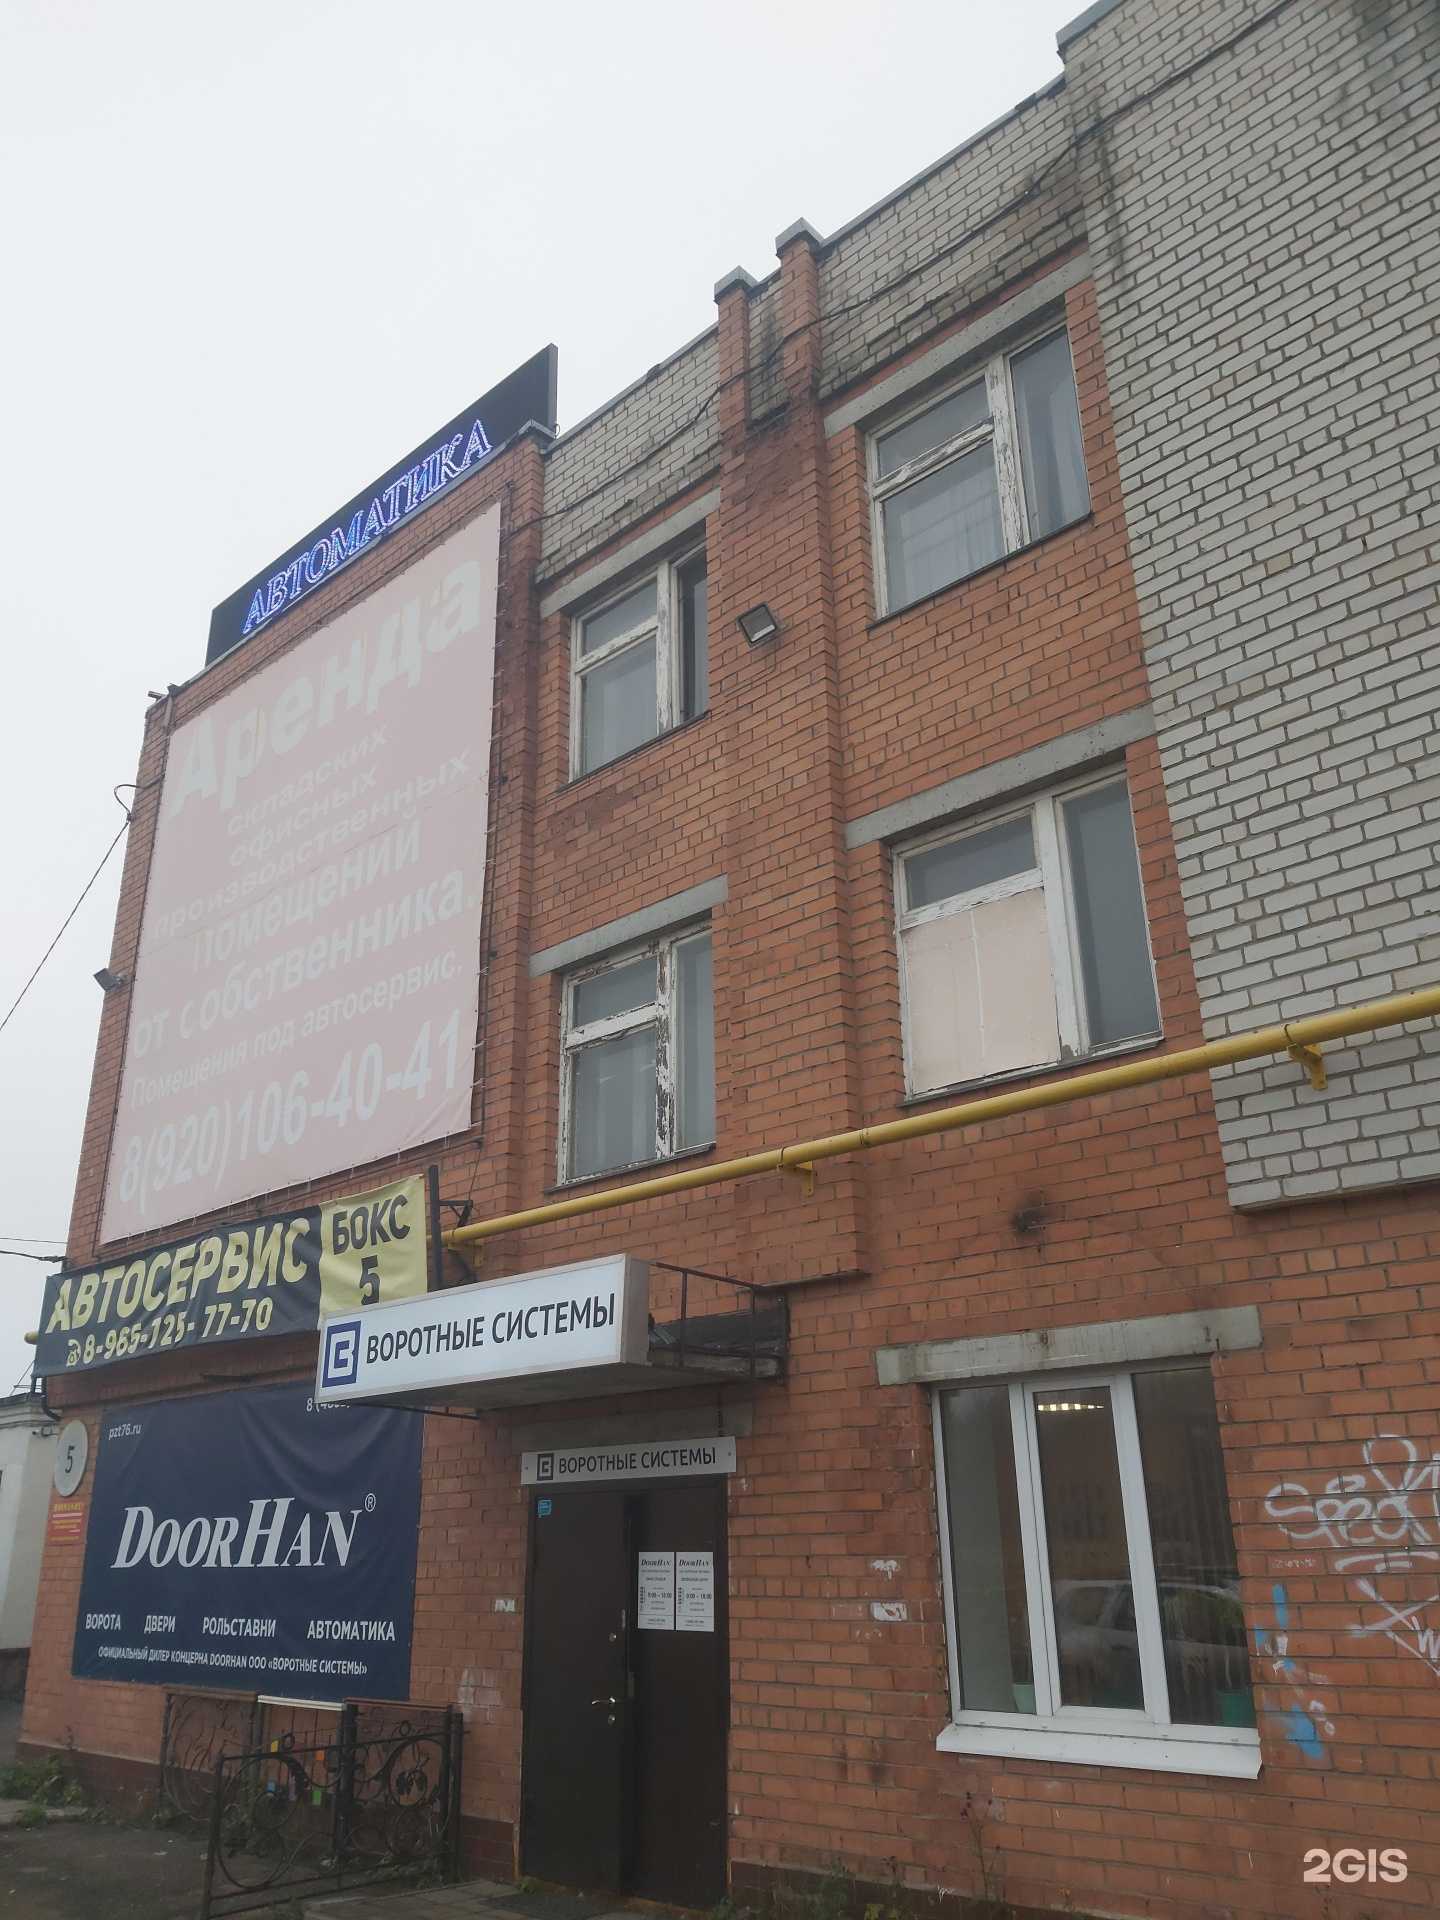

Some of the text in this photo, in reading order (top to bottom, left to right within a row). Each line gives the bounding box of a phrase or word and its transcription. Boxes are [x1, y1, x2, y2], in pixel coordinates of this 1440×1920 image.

[243, 419, 493, 634] АВТОМАТИКА
[167, 560, 480, 821] Аренда
[133, 1008, 171, 1058] от
[252, 1018, 296, 1057] под
[332, 1194, 411, 1255] БОКС
[45, 1217, 311, 1334] АВТОСЕРВИС
[359, 1255, 380, 1305] 5
[366, 1292, 615, 1364] ВОРОТНЫЕ СИСТЕМЫ
[108, 1423, 142, 1440] pzt76.ru
[65, 1445, 76, 1474] 5
[559, 1447, 716, 1474] ВОРОТНЫЕ СИСТЕМЫ
[85, 1613, 396, 1641] ВОРОТА ДВЕРИ РОЛЬСТАВНИ АВТОМАТИКА
[98, 1646, 148, 1660] ОФИЦИАЛЬНЫЙ
[148, 1649, 170, 1662] ДИЛЕР
[170, 1650, 208, 1665] КОНЦЕРНА
[209, 1653, 247, 1668] DOORHAN
[249, 1656, 267, 1669] ООО
[319, 1660, 368, 1675] СИСТЕМЫ»
